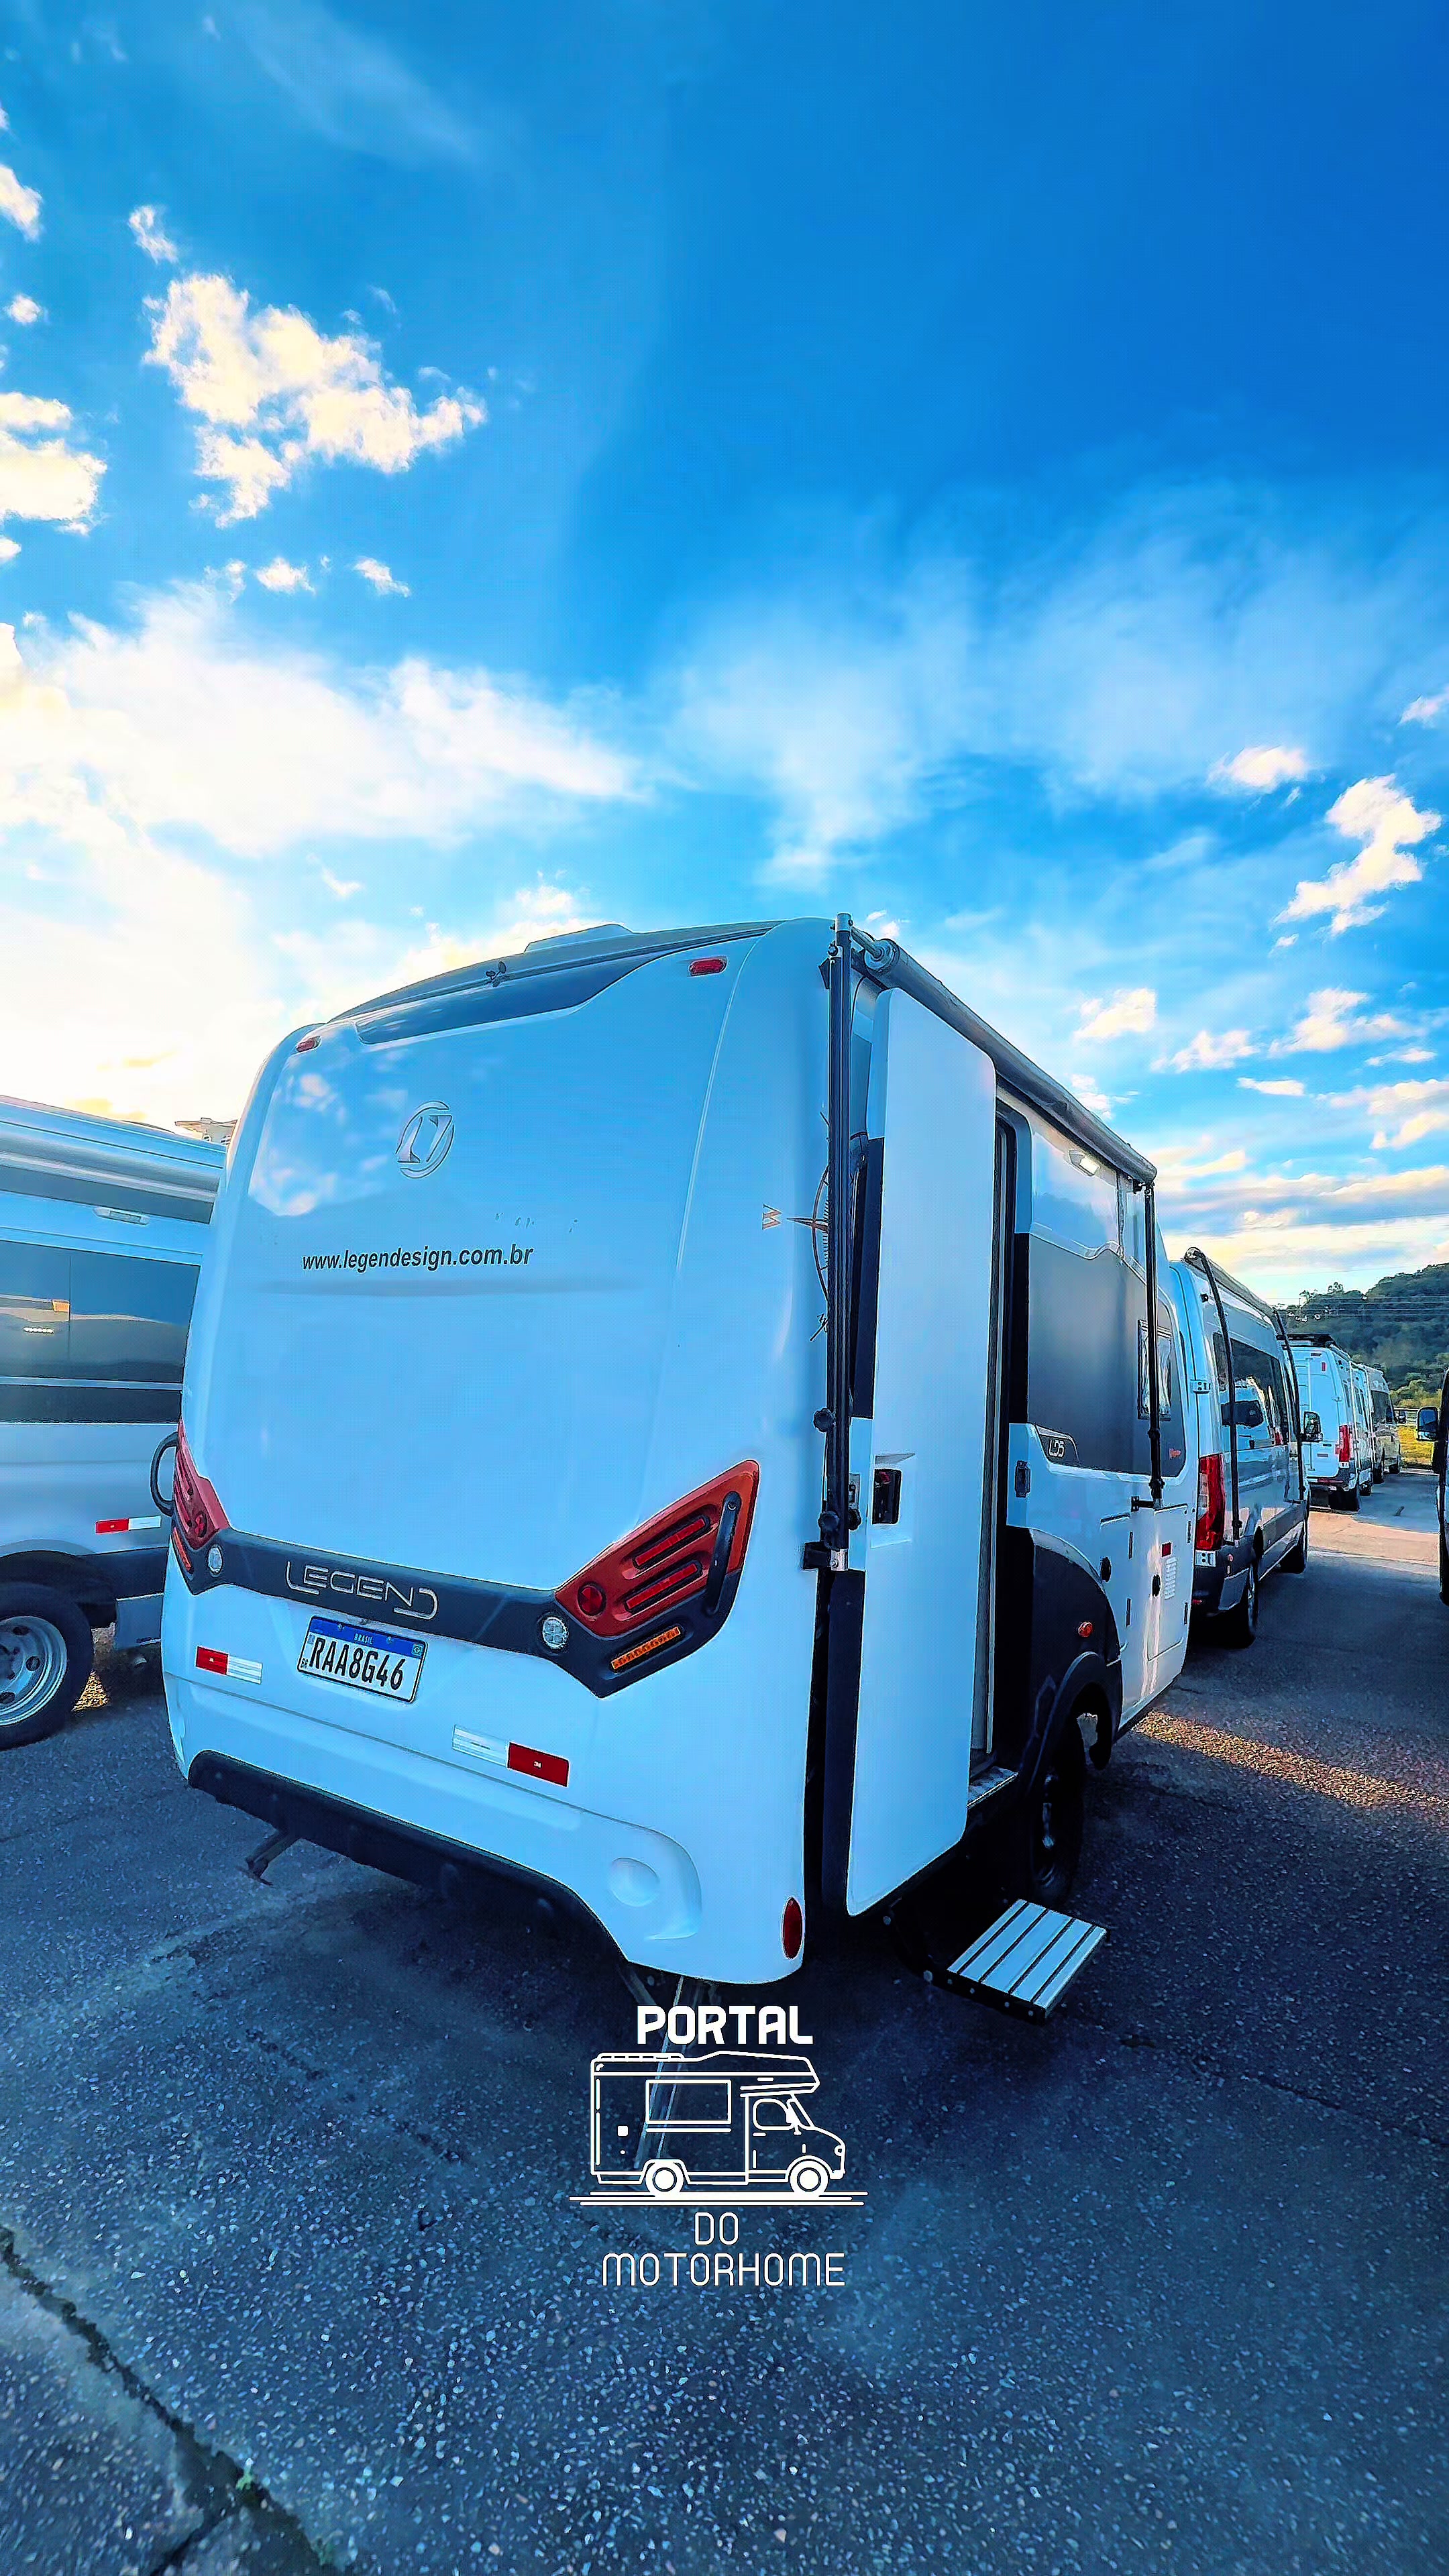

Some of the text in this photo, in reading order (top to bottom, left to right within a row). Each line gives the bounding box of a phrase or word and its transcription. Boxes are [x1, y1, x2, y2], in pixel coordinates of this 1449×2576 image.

[302, 1244, 534, 1273] www.legendesign.com.br
[286, 1560, 439, 1620] LEGEND
[354, 1633, 374, 1645] BRASIL
[309, 1637, 406, 1690] RAA8G46
